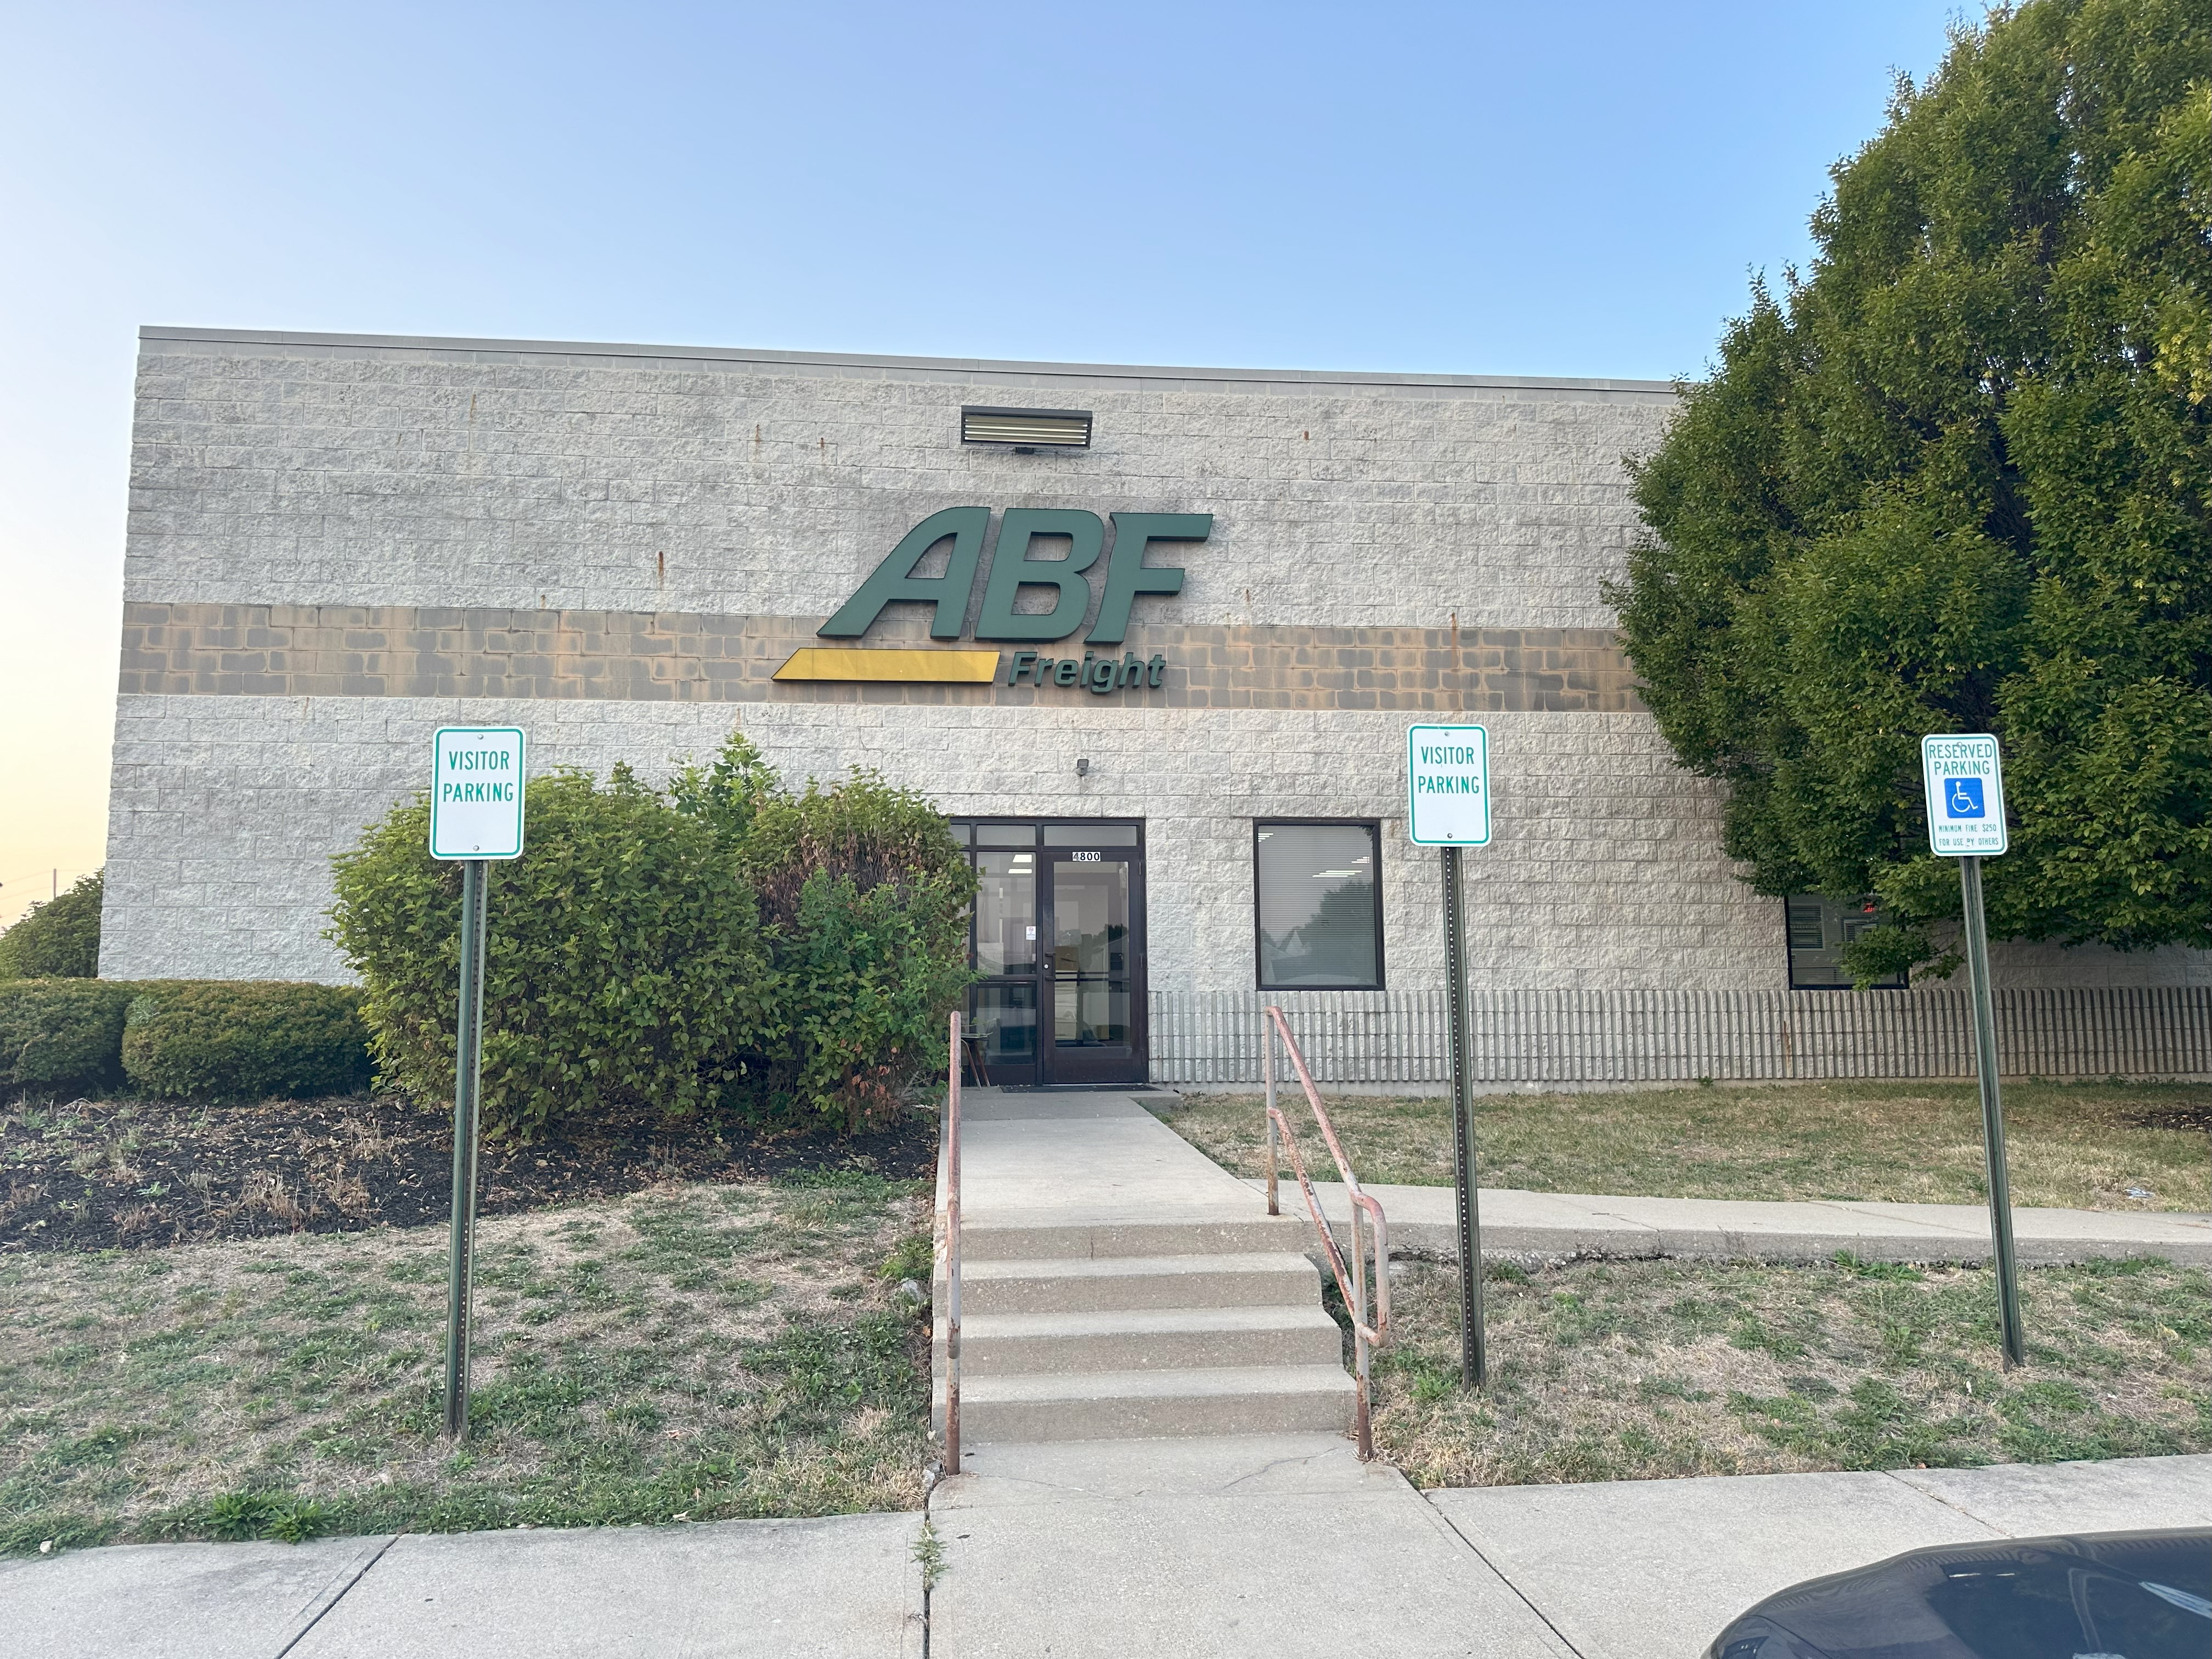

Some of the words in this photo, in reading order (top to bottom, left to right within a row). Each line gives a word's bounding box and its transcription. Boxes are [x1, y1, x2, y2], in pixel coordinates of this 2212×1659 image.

[816, 506, 1214, 645] ABF
[1008, 650, 1167, 695] Freight
[1420, 746, 1475, 765] VISITOR
[1928, 743, 1993, 759] RESERVED
[449, 751, 510, 770] VISITOR
[1934, 760, 1990, 775] PARKING
[443, 782, 514, 802] PARKING
[1418, 776, 1480, 794] PARKING
[1938, 825, 1962, 833] MINIMUM
[1965, 824, 1978, 832] FINE
[1982, 823, 1997, 832] $250
[1939, 838, 1950, 847] FOR
[1953, 838, 1964, 846] USE
[1978, 837, 1999, 846] OTHERS
[1073, 852, 1100, 861] 4800
